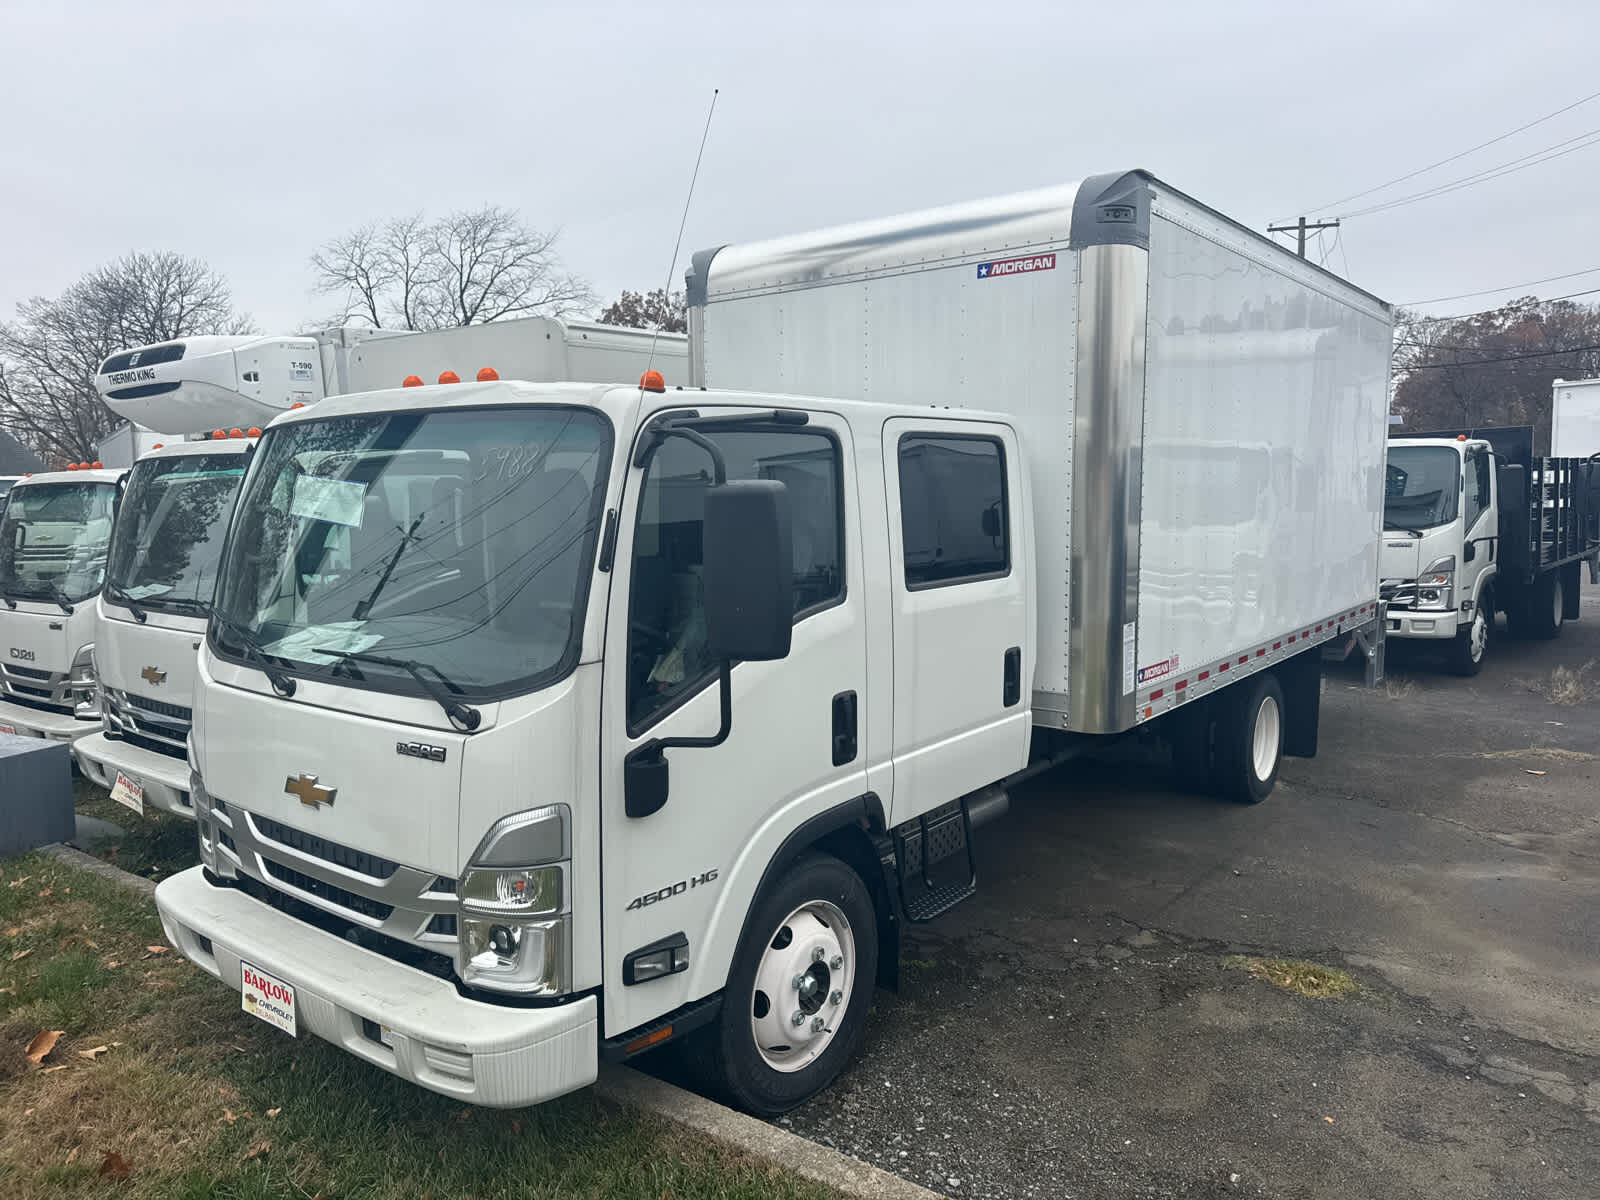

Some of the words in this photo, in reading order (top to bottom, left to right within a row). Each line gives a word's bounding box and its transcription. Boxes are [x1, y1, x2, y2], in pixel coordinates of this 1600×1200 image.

[991, 256, 1053, 275] MORGAN
[291, 361, 313, 370] T-590
[108, 370, 137, 386] THERMO
[137, 367, 156, 381] KING
[626, 881, 687, 911] 4500
[690, 868, 719, 889] HG
[244, 969, 293, 1006] BARLOW
[258, 999, 293, 1022] CHEVROLET
